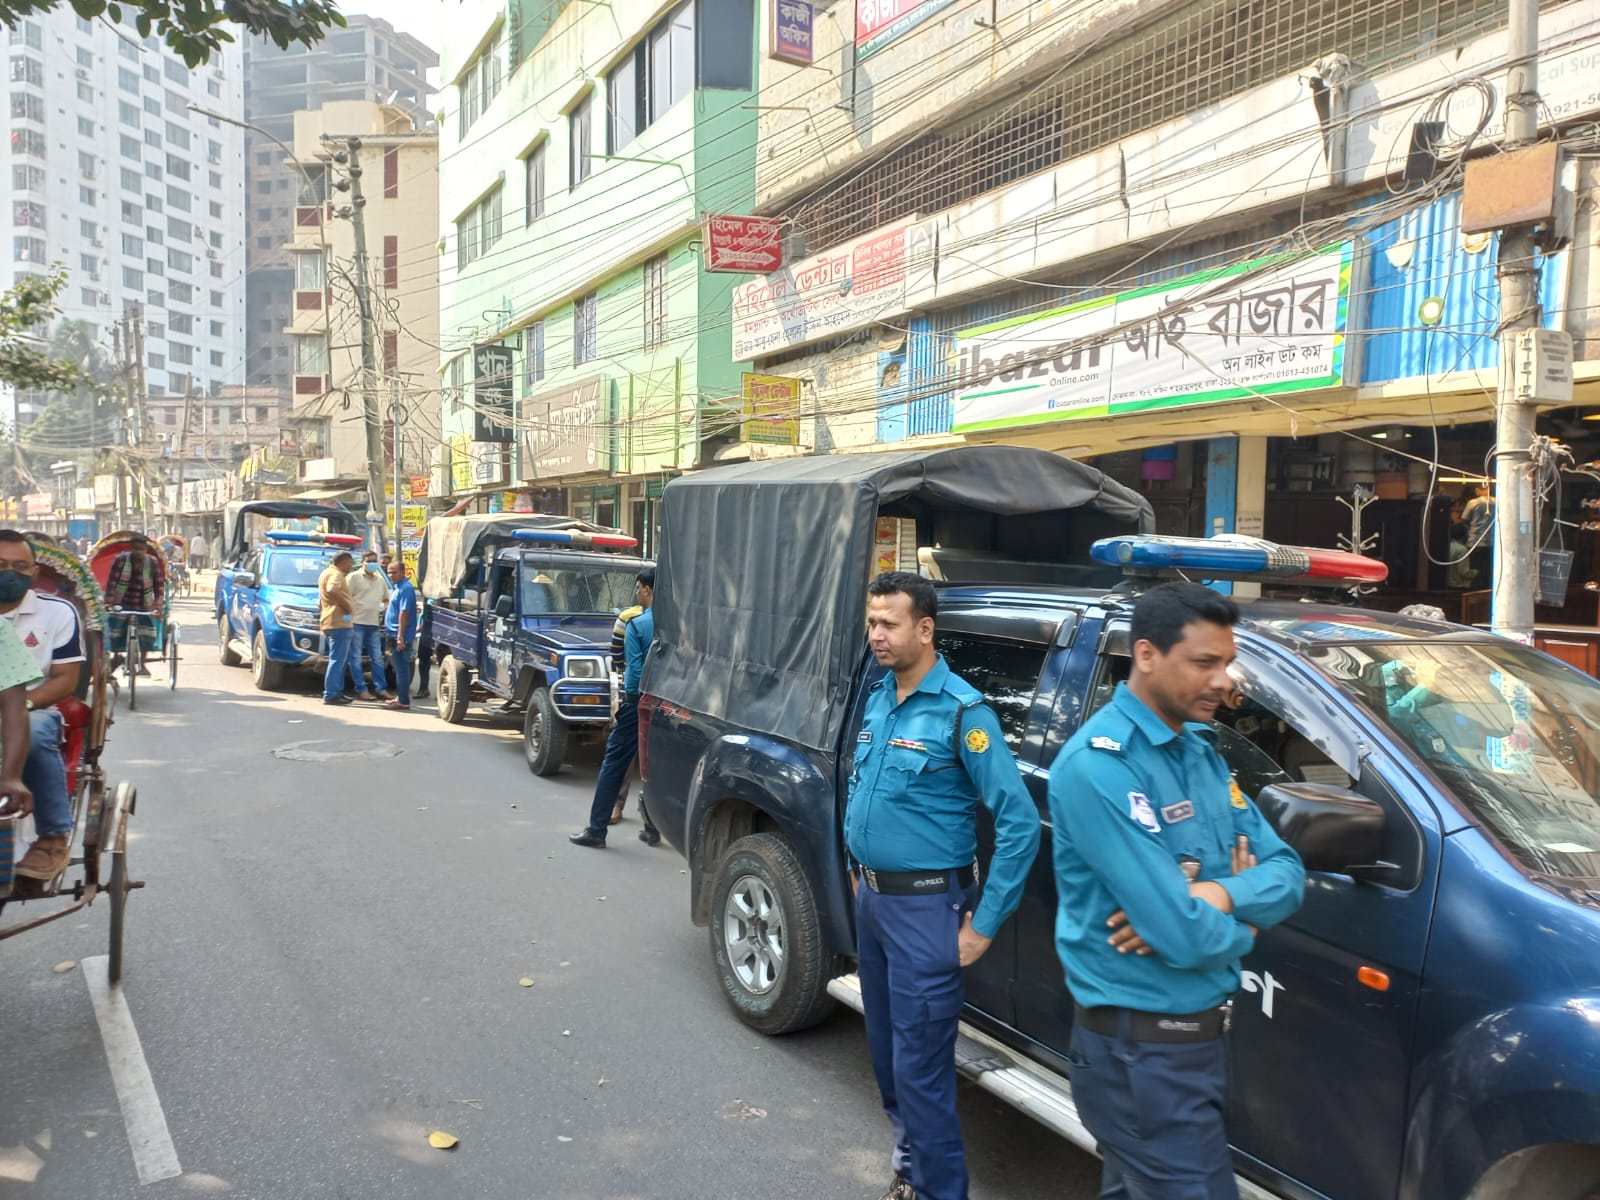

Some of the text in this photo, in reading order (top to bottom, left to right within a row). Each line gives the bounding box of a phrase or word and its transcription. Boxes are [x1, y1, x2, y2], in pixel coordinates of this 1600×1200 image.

[780, 3, 810, 25] কাজী
[795, 257, 849, 291] ডেন্টাল
[1119, 277, 1336, 360] আই বাজার
[1222, 343, 1323, 372] অন লাইন ডট কম
[1050, 372, 1099, 388] Online.com
